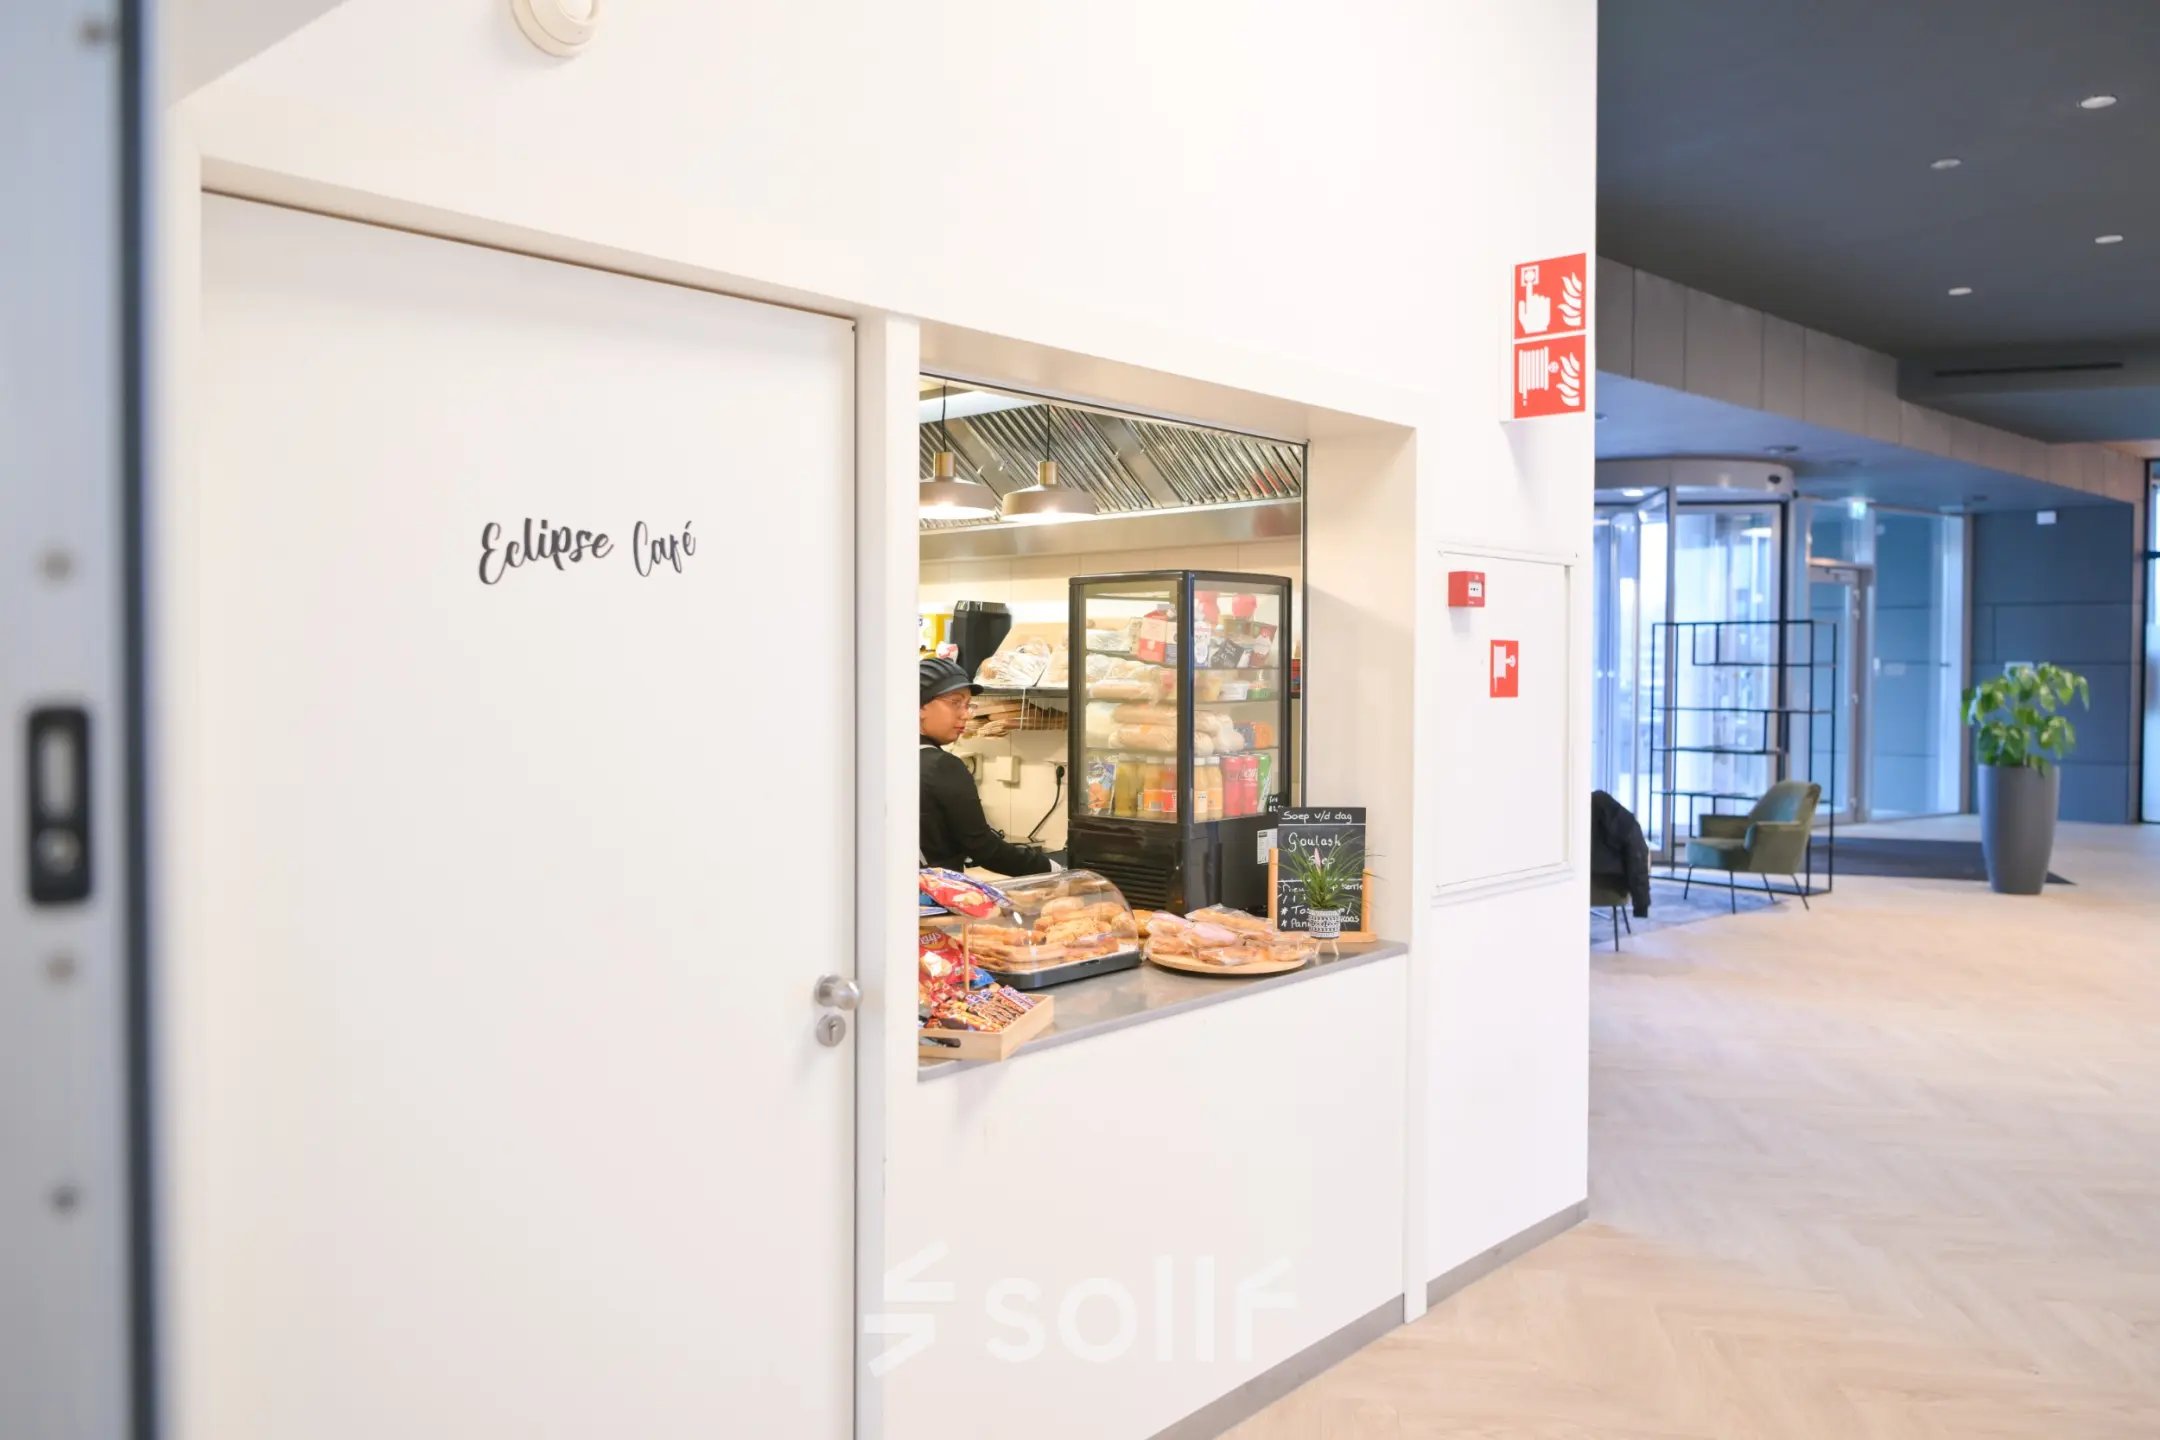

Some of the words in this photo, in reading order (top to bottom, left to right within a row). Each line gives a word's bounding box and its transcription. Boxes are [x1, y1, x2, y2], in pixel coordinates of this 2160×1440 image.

[478, 517, 615, 585] Eclipse
[632, 520, 696, 577] Café
[1281, 810, 1310, 824] Soep
[1314, 810, 1331, 823] v/d
[1334, 811, 1353, 825] dag
[1288, 831, 1342, 852] Goulash
[1308, 855, 1336, 870] Sep
[1290, 904, 1310, 915] Tos
